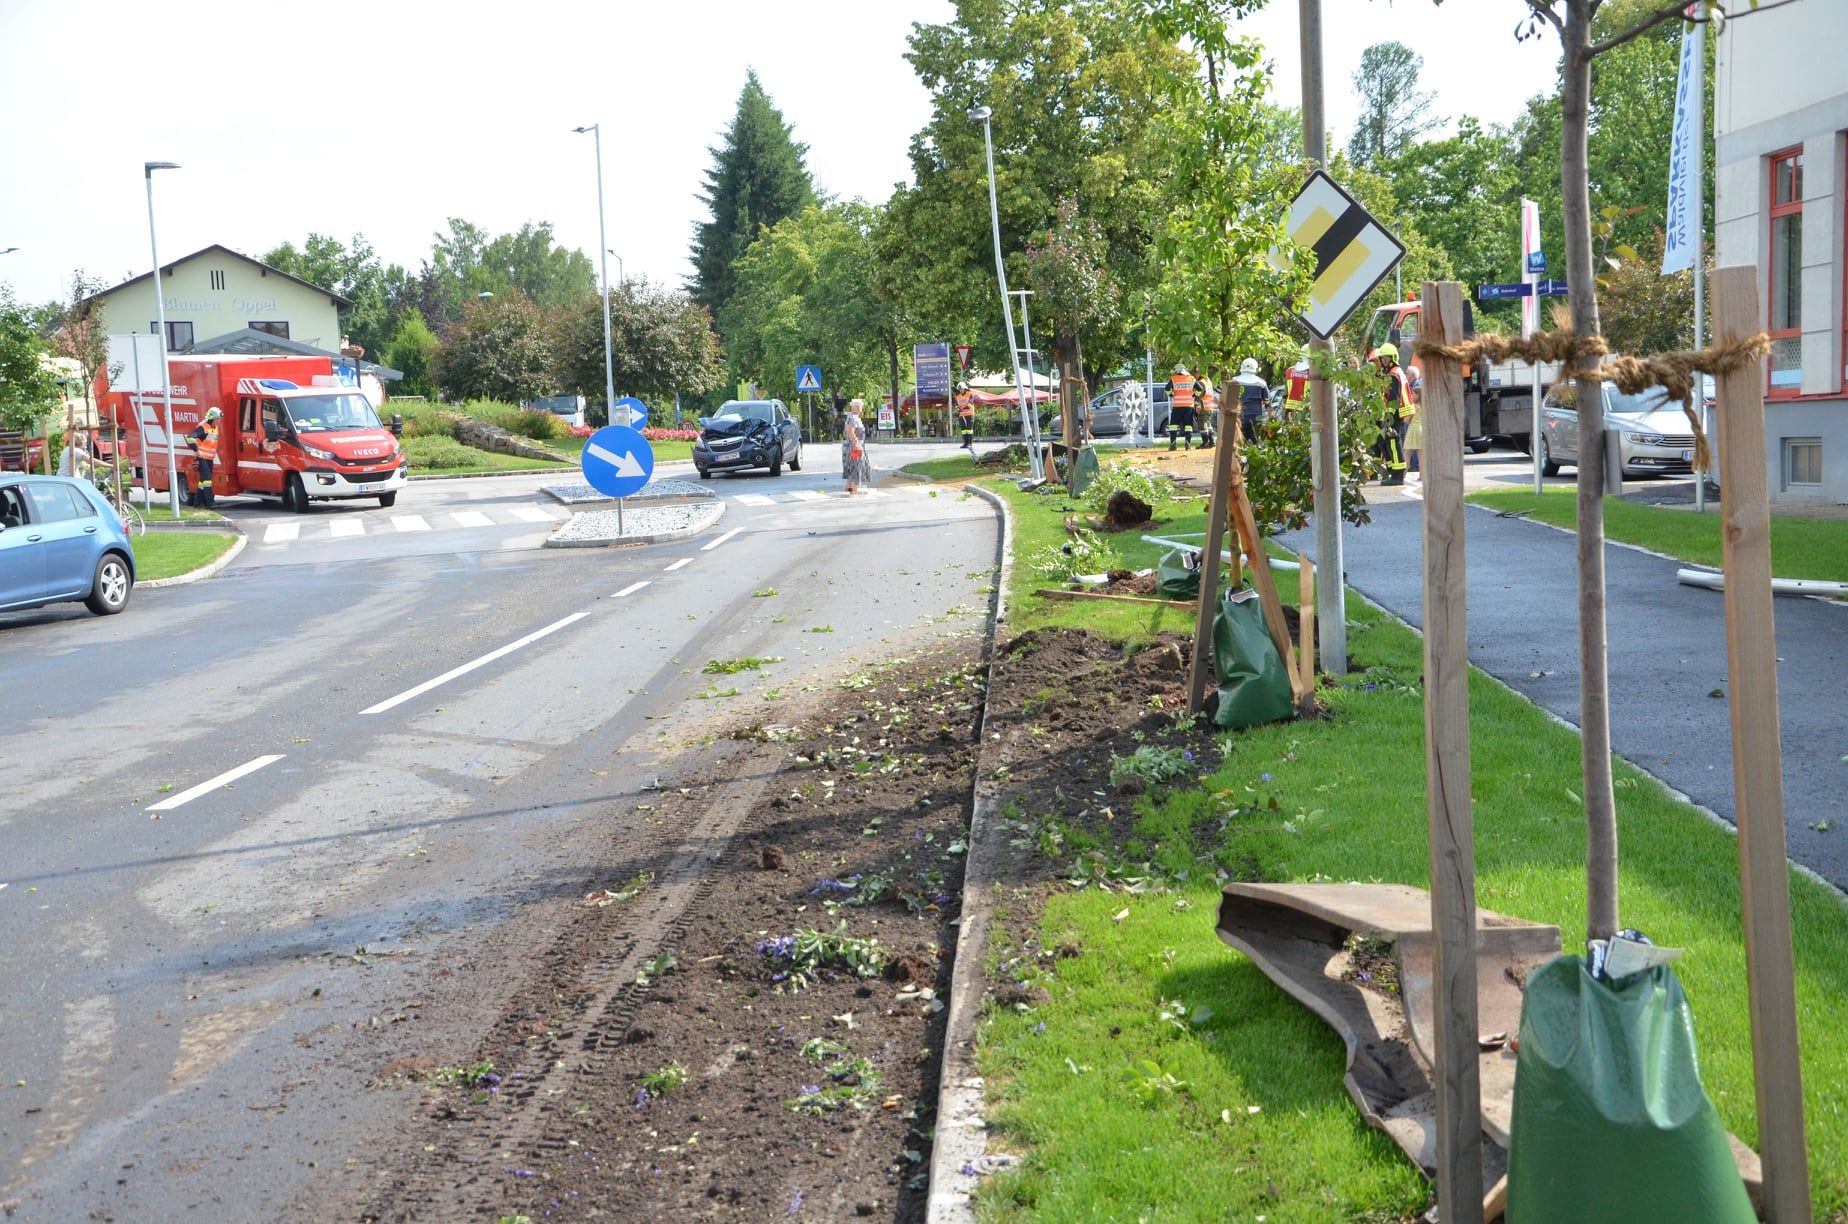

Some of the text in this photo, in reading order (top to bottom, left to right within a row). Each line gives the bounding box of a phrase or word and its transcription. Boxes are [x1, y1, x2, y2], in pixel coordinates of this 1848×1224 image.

[163, 298, 277, 315] Blumen Oppel
[174, 411, 199, 422] MARTIN
[880, 412, 891, 420] EIS
[353, 448, 379, 456] IVECO
